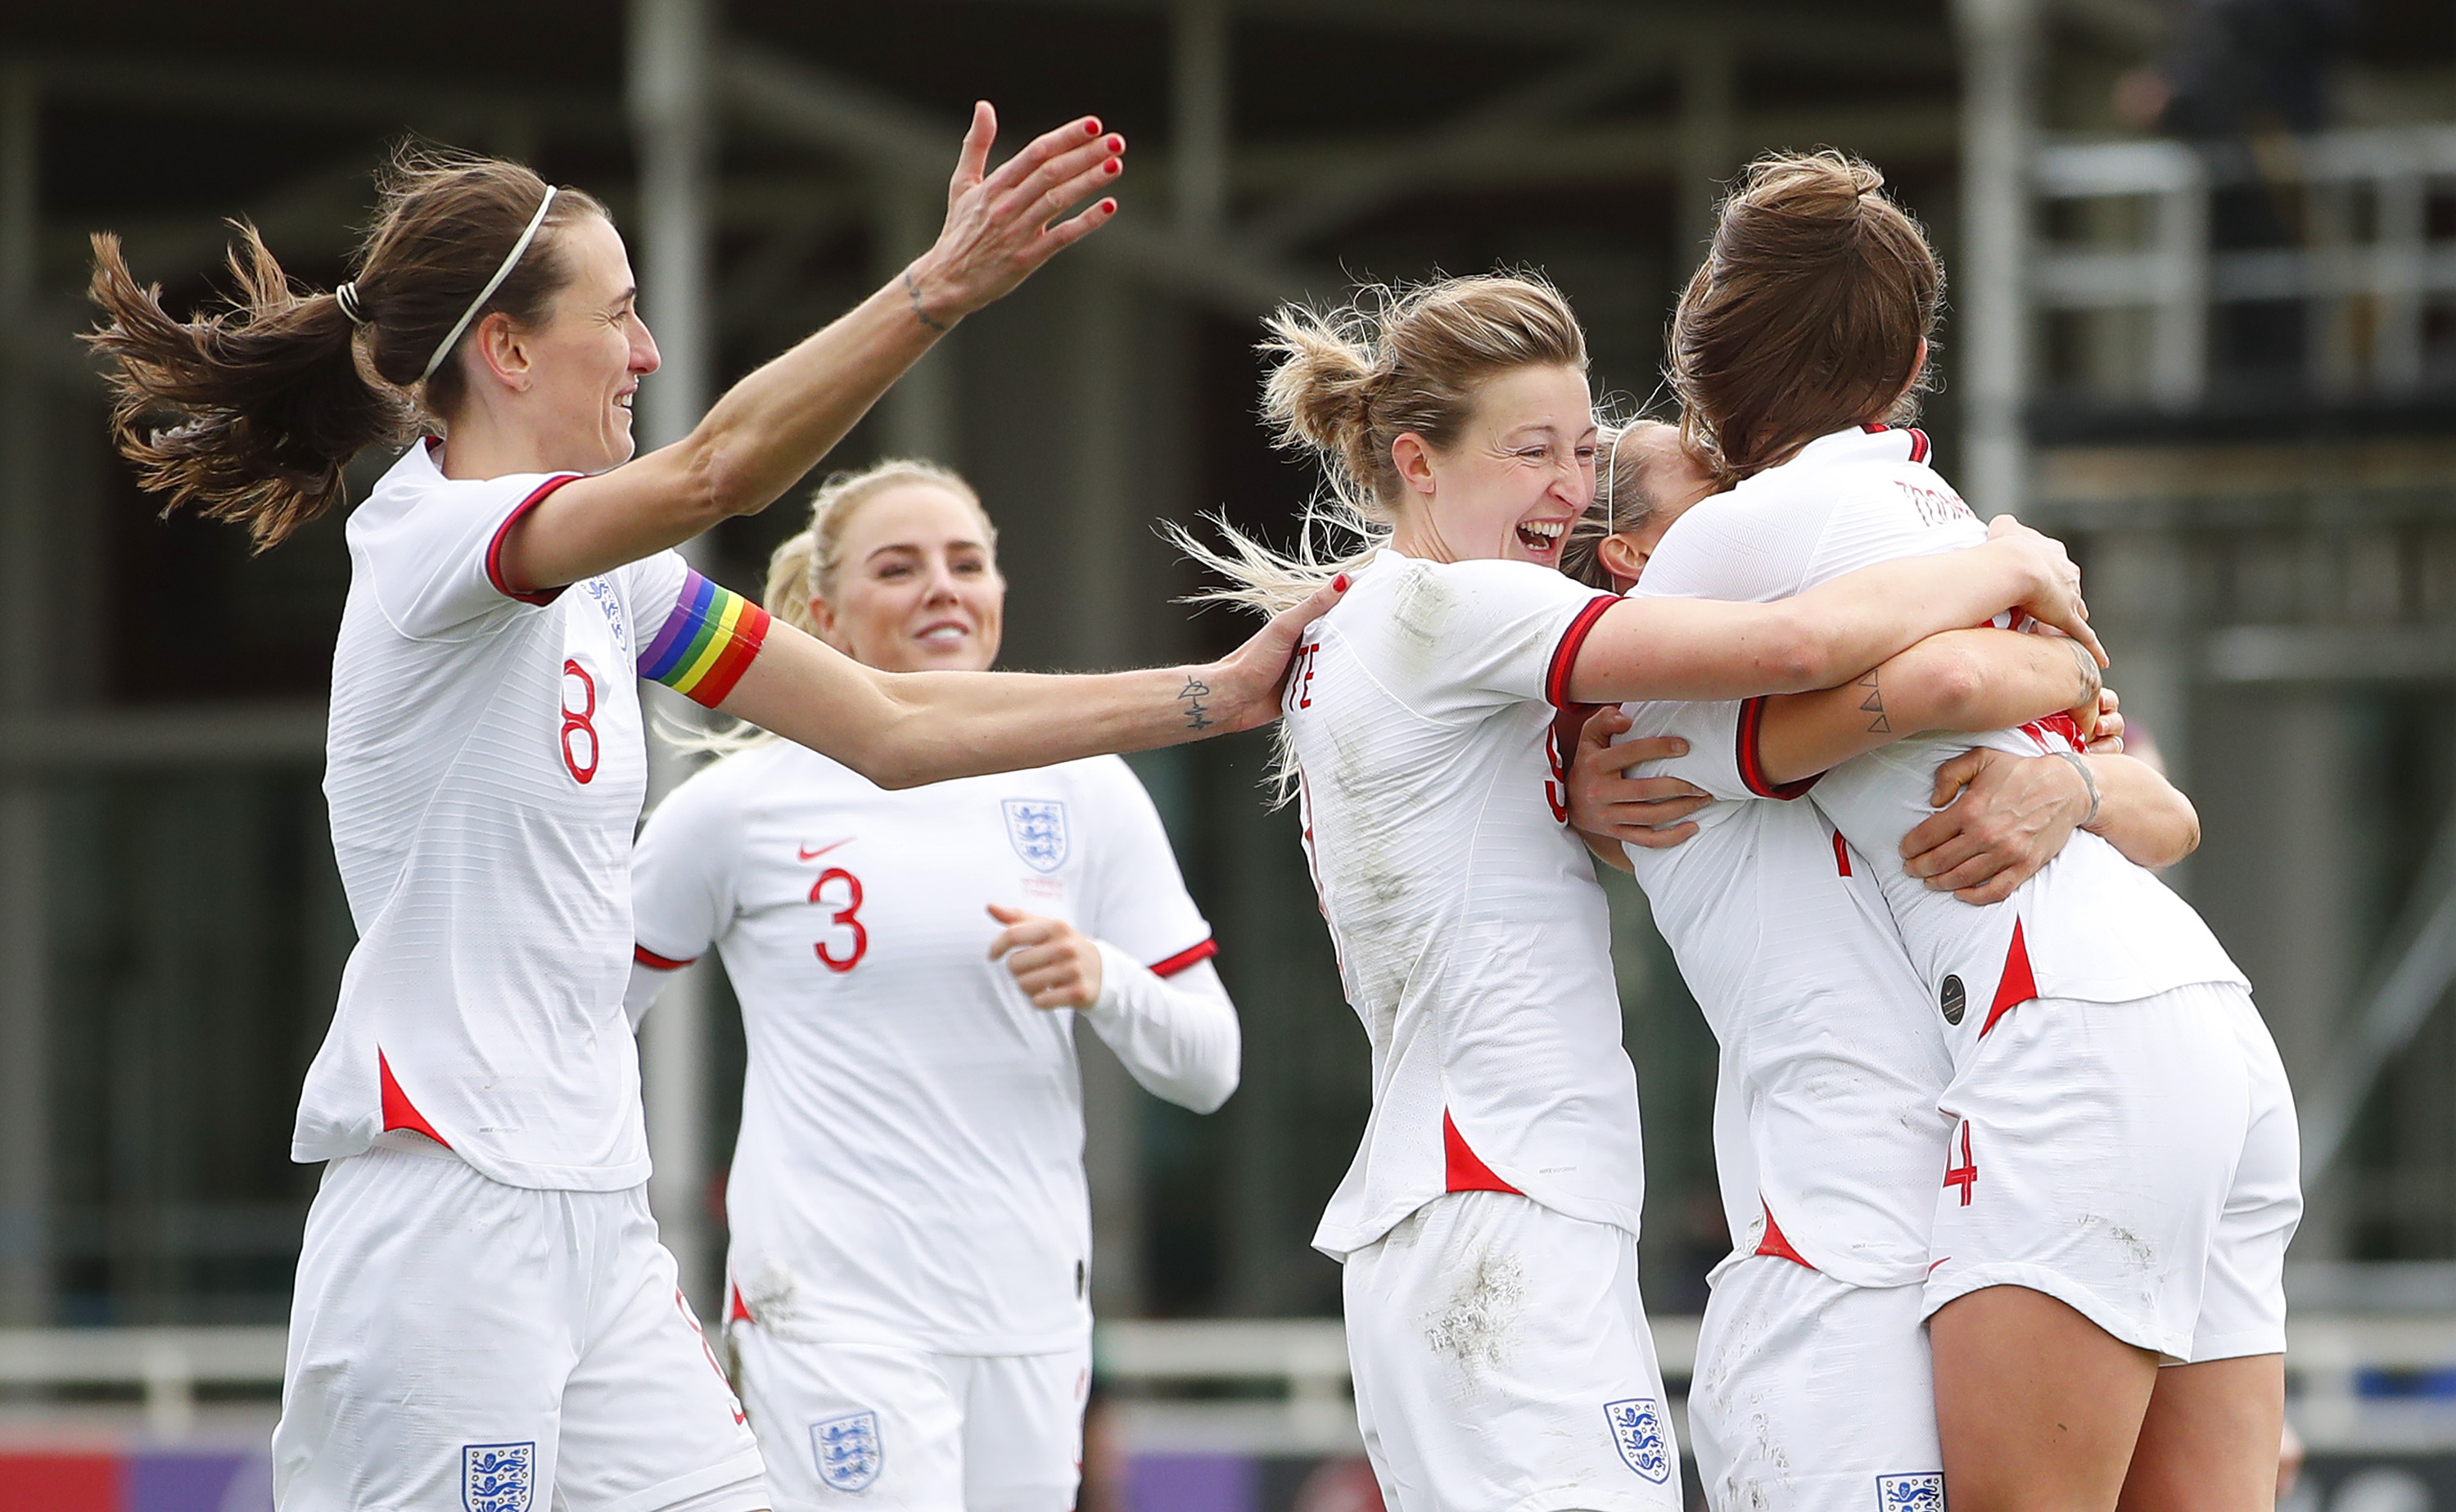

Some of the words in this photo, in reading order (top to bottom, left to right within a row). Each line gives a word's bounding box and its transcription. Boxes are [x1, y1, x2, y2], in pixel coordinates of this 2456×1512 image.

[560, 658, 599, 785] 8
[809, 867, 867, 973] 3
[1942, 1118, 1978, 1207] 4
